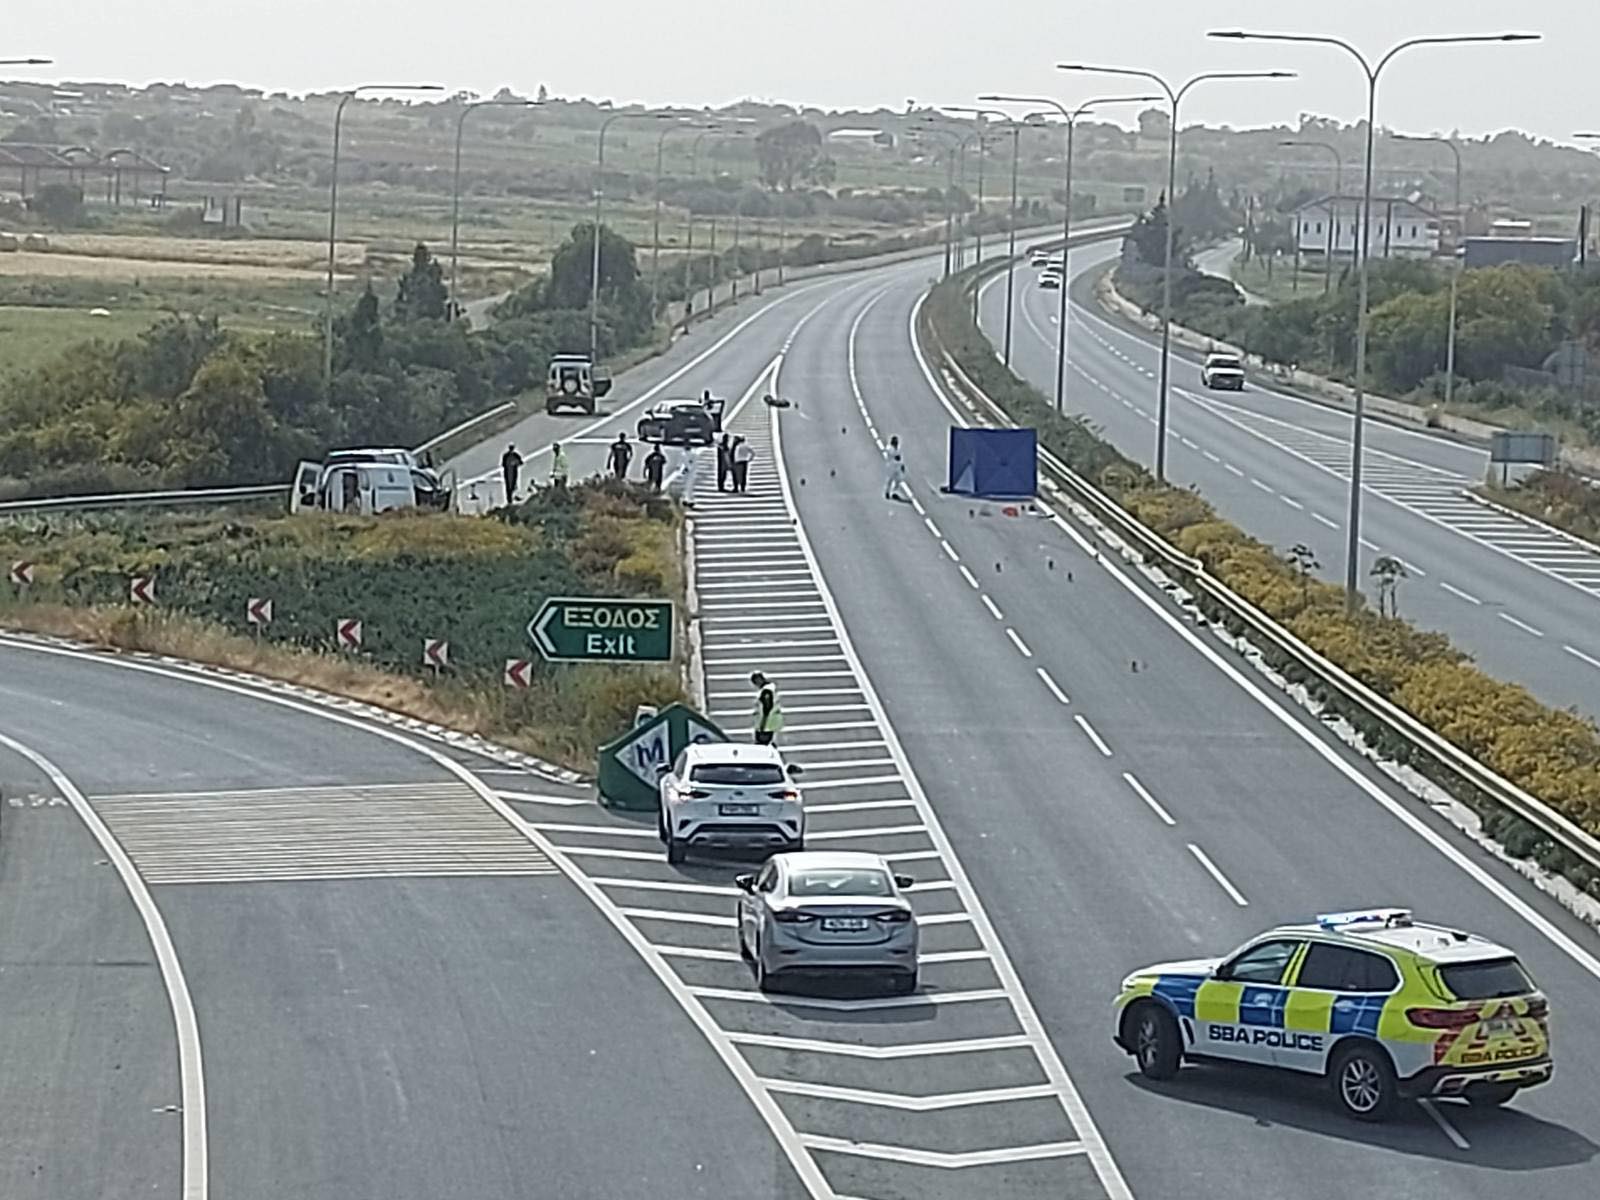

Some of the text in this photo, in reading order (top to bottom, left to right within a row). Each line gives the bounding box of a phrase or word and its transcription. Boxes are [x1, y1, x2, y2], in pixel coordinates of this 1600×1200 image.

[564, 607, 660, 628] ΕΞΟΔΟΣ
[587, 634, 636, 654] Exit
[1209, 1024, 1323, 1052] SBA POLICE
